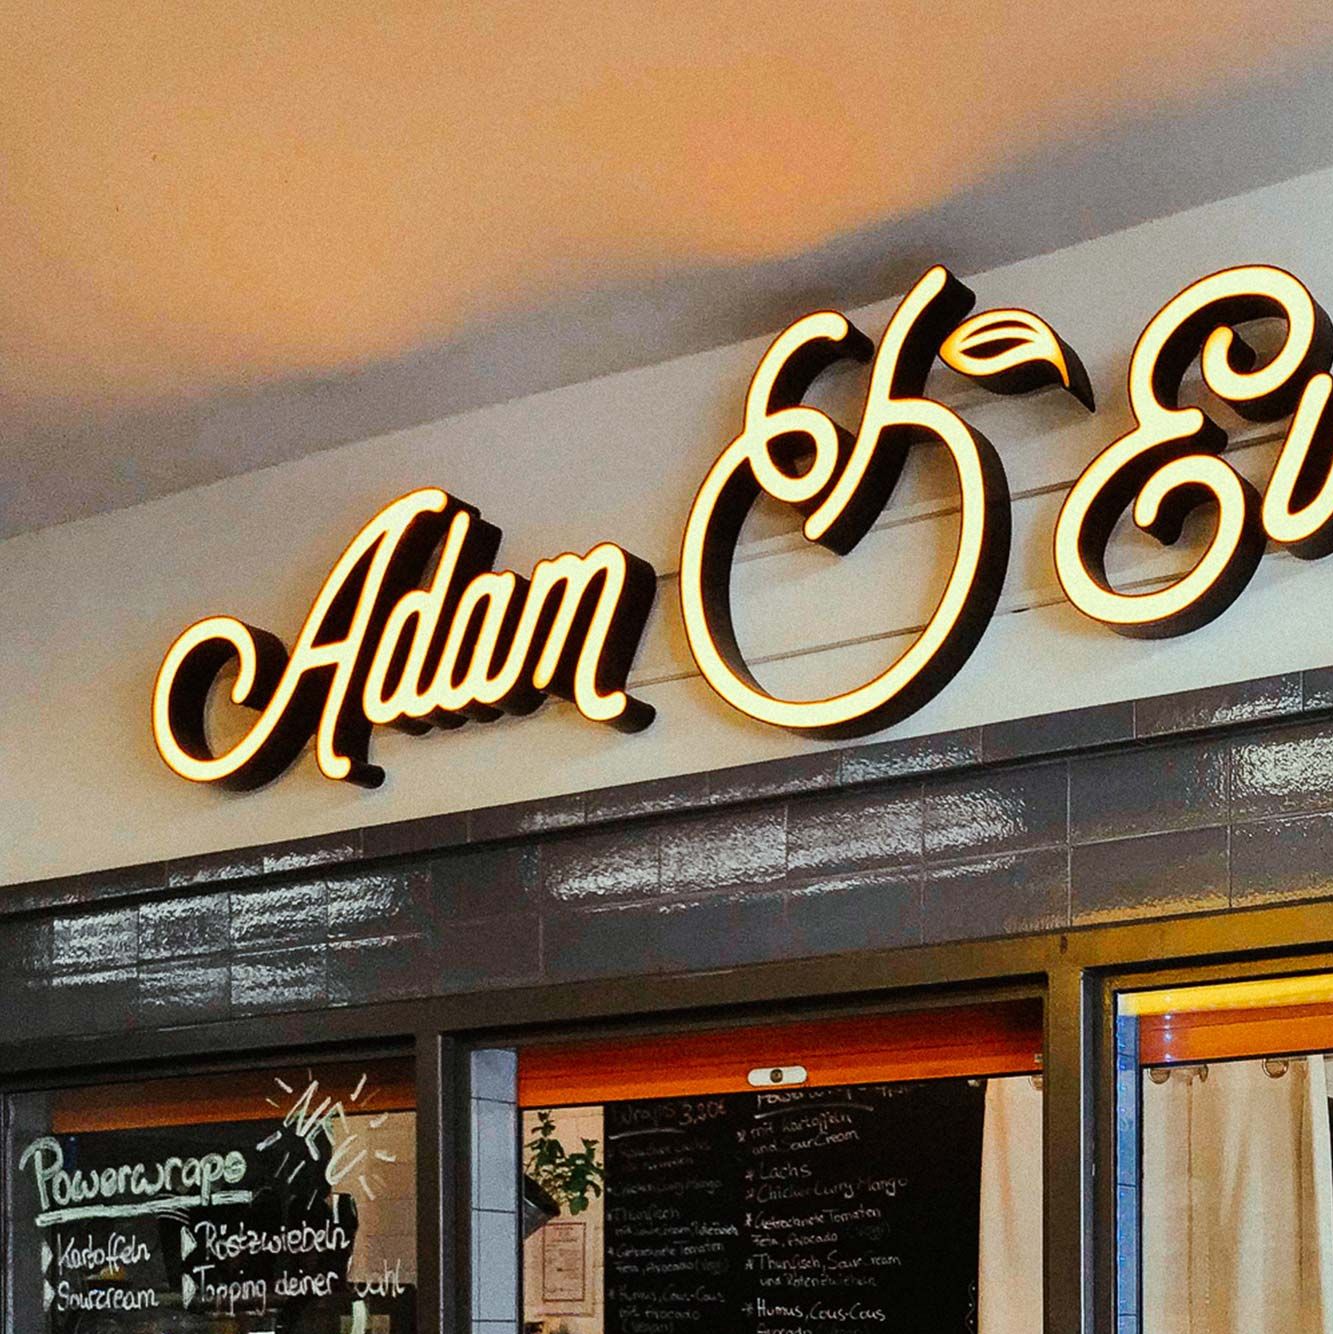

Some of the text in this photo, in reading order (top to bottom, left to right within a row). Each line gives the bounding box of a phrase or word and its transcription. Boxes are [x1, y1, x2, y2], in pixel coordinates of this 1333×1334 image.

[151, 486, 640, 786] Adam
[19, 1136, 247, 1210] Powerwraps
[760, 1160, 813, 1181] Lachs
[57, 1232, 151, 1275] Kartoffeln
[193, 1265, 267, 1316] Topping
[275, 1270, 339, 1296] deiner
